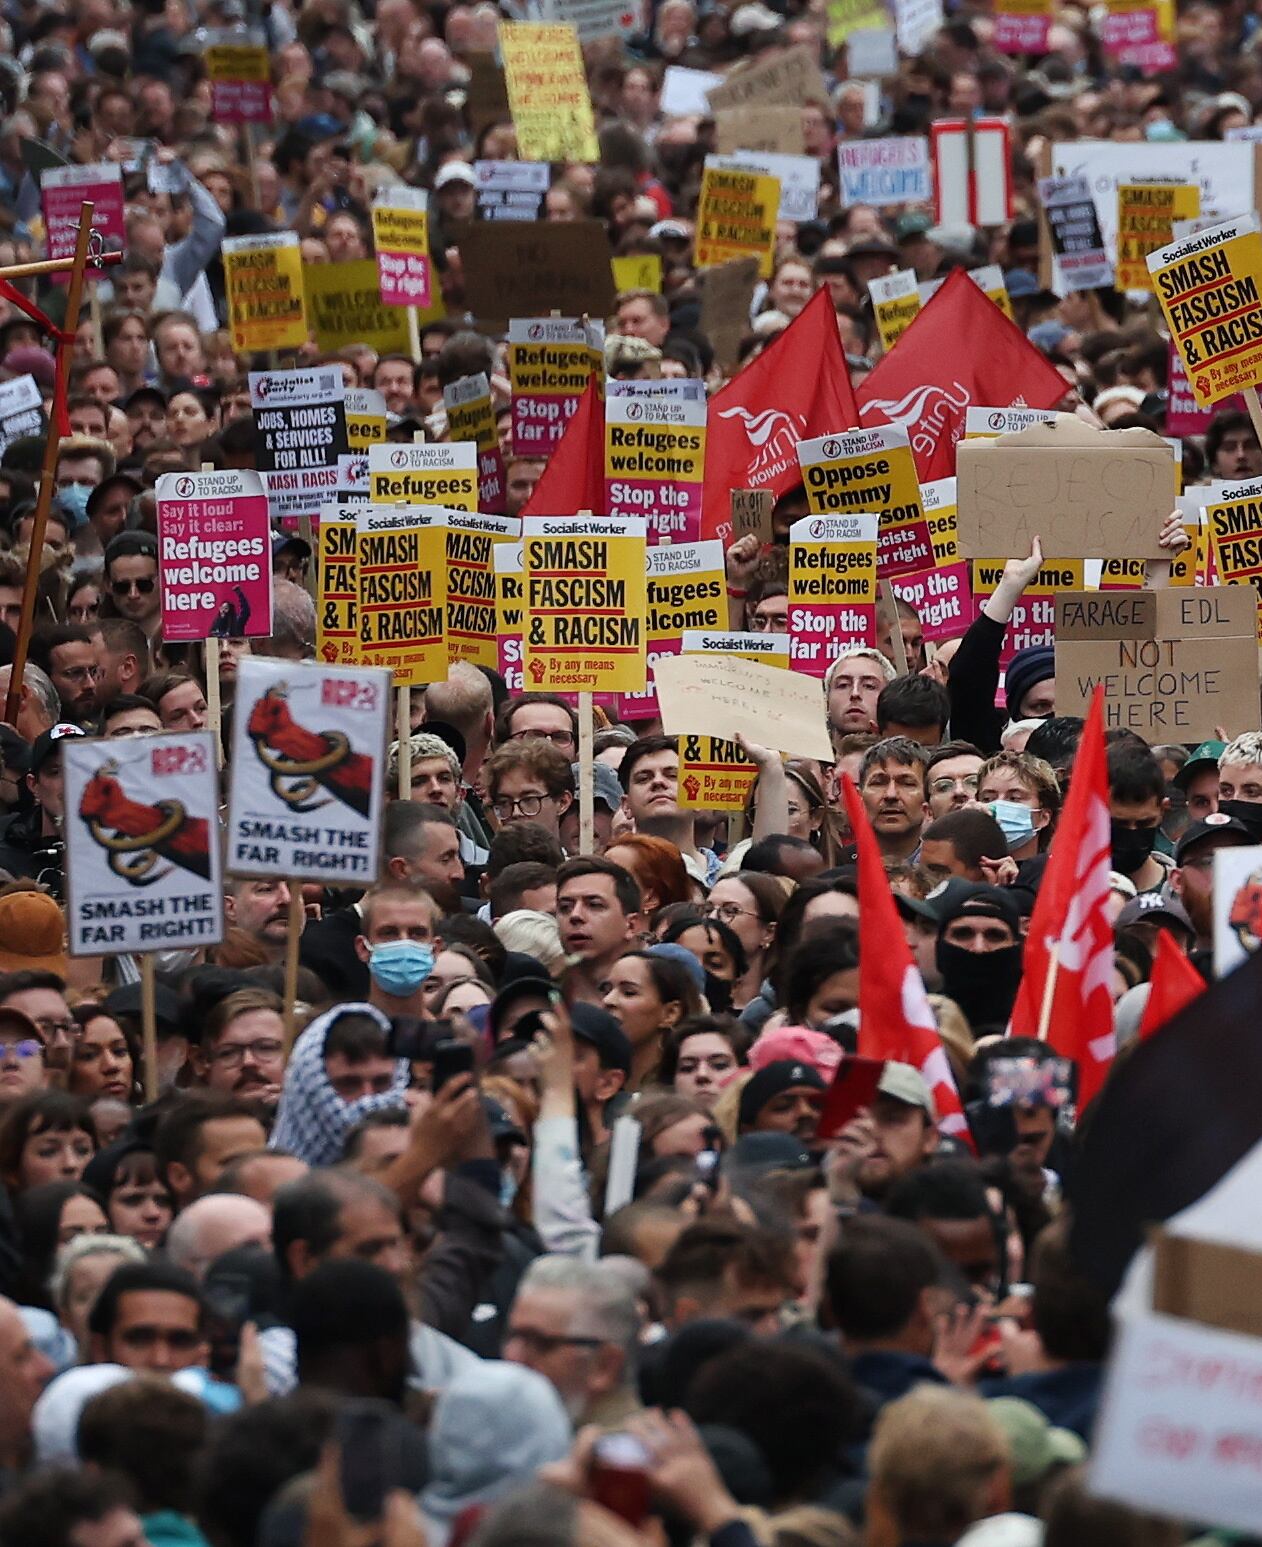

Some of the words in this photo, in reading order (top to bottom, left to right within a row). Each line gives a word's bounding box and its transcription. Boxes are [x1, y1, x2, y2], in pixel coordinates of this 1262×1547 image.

[1158, 249, 1232, 299] SMASH
[1170, 276, 1260, 333] FASCISM
[1183, 339, 1202, 365] &
[267, 376, 314, 387] Socialist
[1210, 368, 1222, 380] By
[1224, 362, 1239, 375] any
[1215, 369, 1258, 392] necessary
[258, 410, 289, 431] JOBS,
[290, 407, 336, 427] HOMES
[517, 399, 559, 421] Stop
[1007, 413, 1037, 423] STAND
[266, 435, 273, 449] &
[276, 428, 333, 447] SERVICES
[517, 420, 544, 440] far
[611, 428, 700, 451] Refugees
[274, 452, 297, 468] FOR
[301, 449, 327, 466] ALL!
[611, 452, 694, 473] welcome
[198, 477, 226, 486] STAND
[229, 476, 238, 484] UP
[376, 475, 472, 498] Refugees
[808, 459, 889, 488] Oppose
[972, 458, 1161, 508] REJECT
[198, 487, 209, 495] TO
[212, 485, 243, 494] RACISM
[813, 483, 891, 511] Tommy
[163, 504, 183, 518] Say
[188, 503, 200, 516] it
[203, 502, 233, 515] loud
[543, 522, 588, 534] Socialist
[589, 523, 626, 535] Worker
[977, 510, 1159, 548] RACISM
[360, 533, 418, 566] SMASH
[530, 541, 607, 569] SMASH
[653, 551, 681, 562] STAND
[684, 549, 696, 560] UP
[794, 547, 873, 573] Refugees
[654, 562, 667, 572] TO
[669, 559, 700, 571] RACISM
[360, 571, 431, 604] FASCISM
[530, 579, 625, 607] FASCISM
[793, 574, 869, 595] welcome
[323, 601, 339, 629] &
[361, 614, 372, 642] &
[378, 607, 443, 641] RACISM
[791, 610, 835, 636] Stop
[840, 610, 867, 631] the
[918, 599, 961, 626] right
[1062, 600, 1145, 627] FARAGE
[1182, 599, 1230, 624] EDL
[530, 617, 546, 645] &
[554, 617, 639, 646] RACISM
[702, 638, 742, 650] Socialist
[744, 639, 774, 651] Worker
[791, 637, 821, 659] far
[1119, 640, 1181, 668] NOT
[549, 658, 560, 673] By
[563, 660, 582, 674] any
[584, 659, 615, 671] means
[549, 673, 598, 687] necessary
[1078, 670, 1221, 698] WELCOME
[1107, 701, 1190, 728] HERE
[239, 819, 323, 844] SMASH
[326, 829, 369, 849] THE
[236, 844, 279, 862] FAR
[293, 853, 369, 871] RIGHT!
[81, 896, 168, 920] SMASH
[172, 893, 212, 912] THE
[81, 924, 125, 944] FAR
[140, 917, 214, 939] RIGHT!
